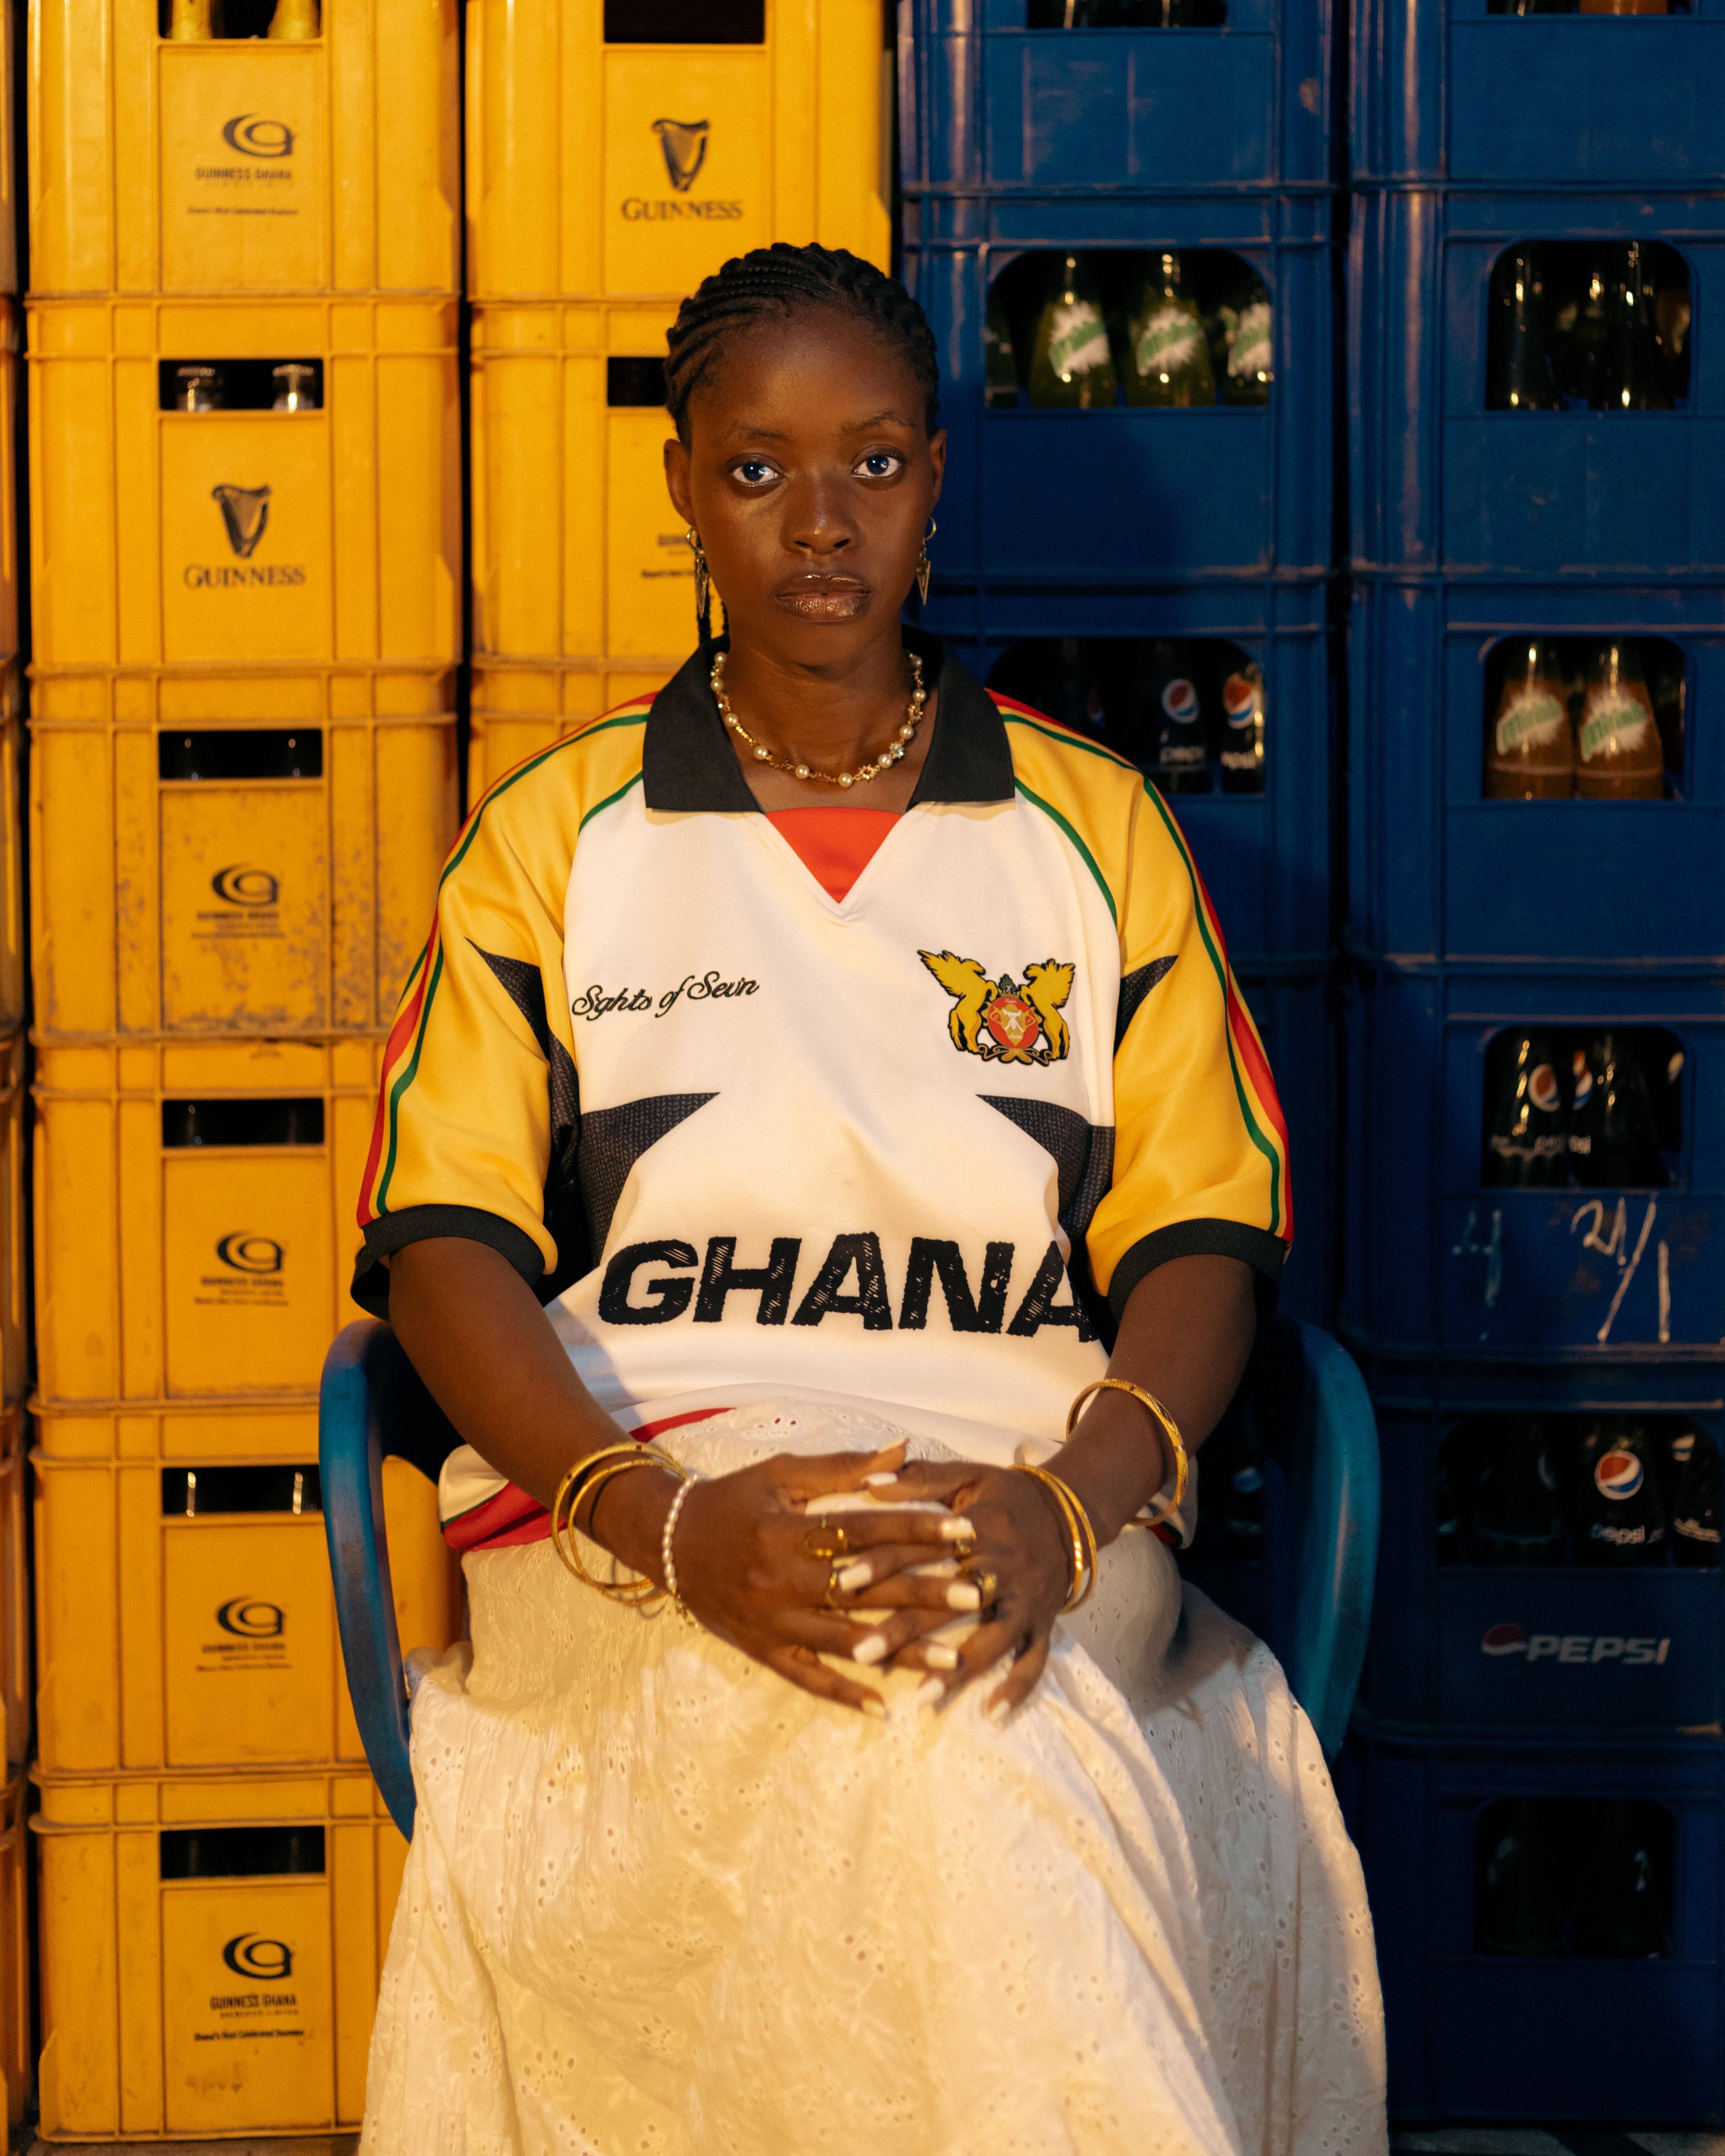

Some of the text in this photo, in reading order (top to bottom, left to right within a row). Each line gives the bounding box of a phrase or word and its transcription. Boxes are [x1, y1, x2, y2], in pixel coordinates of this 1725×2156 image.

[622, 197, 744, 221] GUINNESS
[184, 564, 306, 589] GUINNESS
[655, 975, 695, 1018] of
[598, 1232, 1101, 1343] GHANA
[1528, 1635, 1671, 1665] PEPSI
[210, 1994, 296, 2009] GUINNESS GHANA
